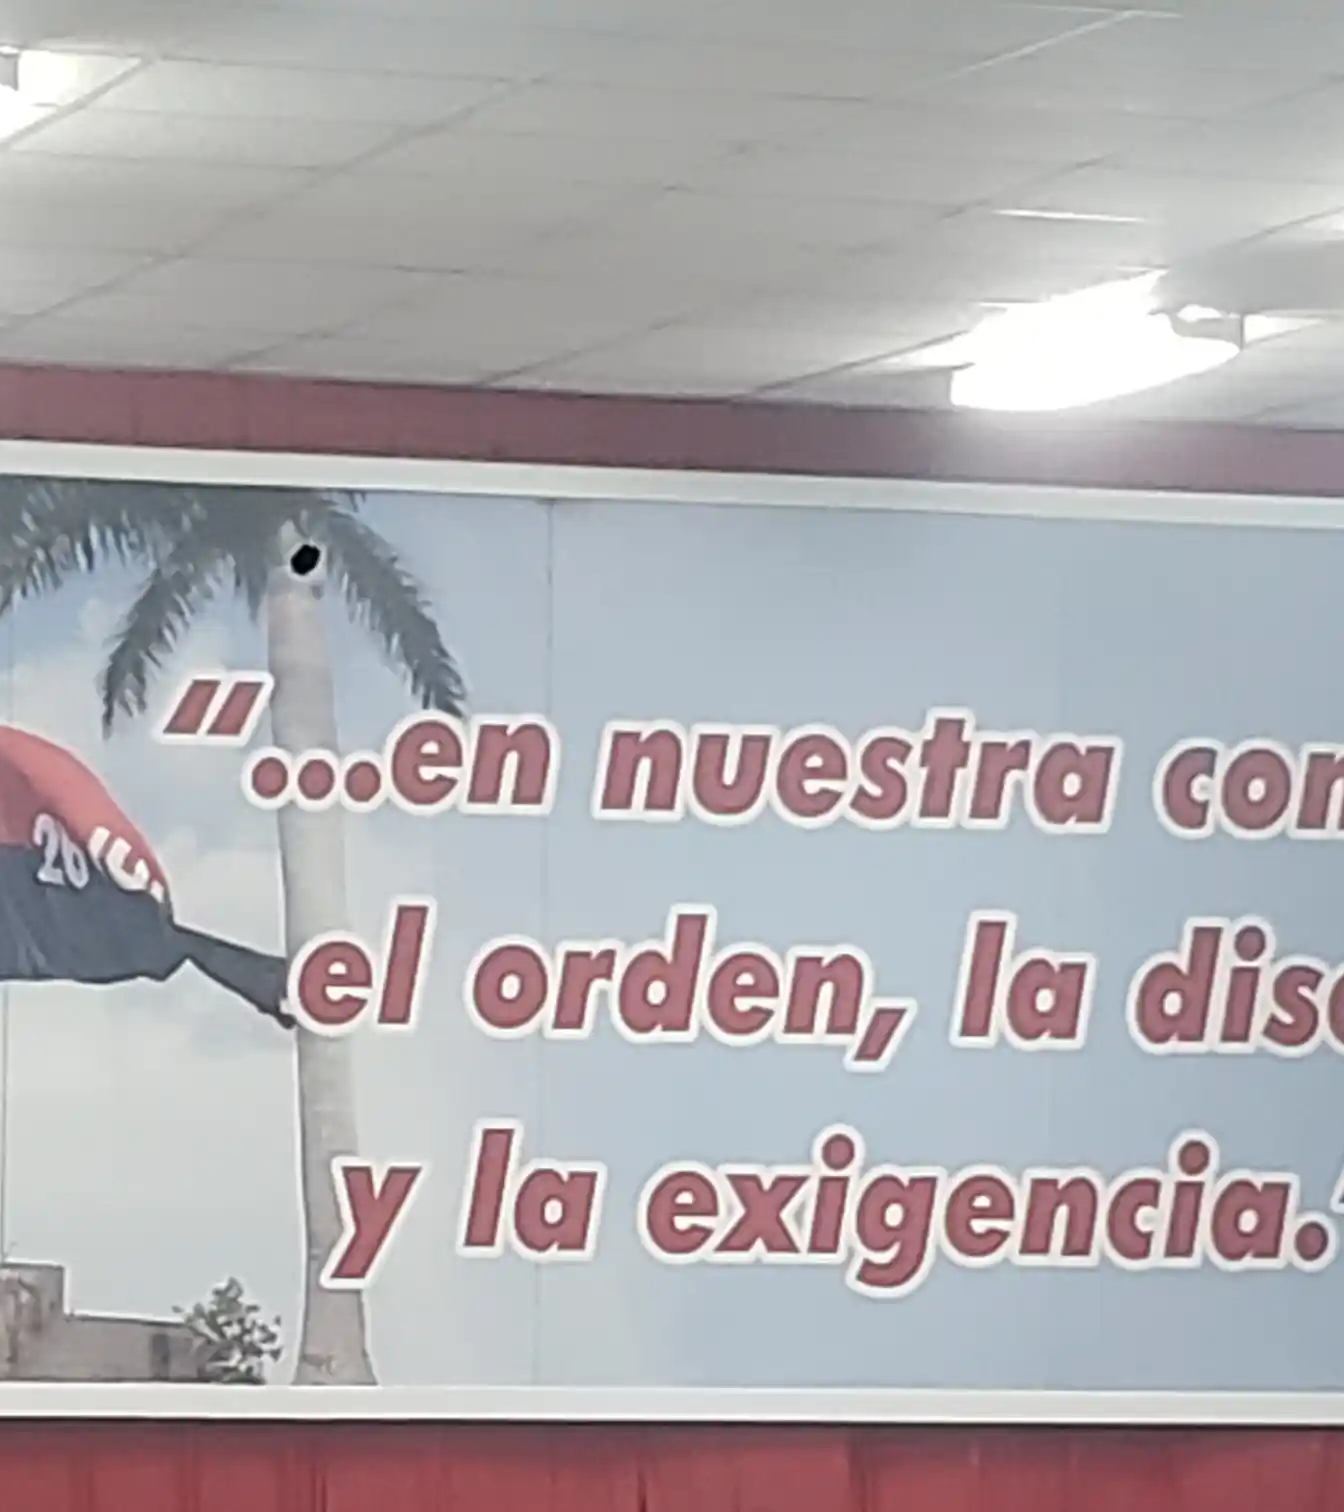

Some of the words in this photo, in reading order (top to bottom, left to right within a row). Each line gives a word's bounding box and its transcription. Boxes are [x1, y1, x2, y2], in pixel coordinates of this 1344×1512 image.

[598, 714, 1118, 828] nuestra
[295, 902, 432, 1028] el
[469, 910, 910, 1064] orden,
[957, 917, 1091, 1044] la
[327, 1162, 425, 1282] y
[460, 1125, 601, 1254] la
